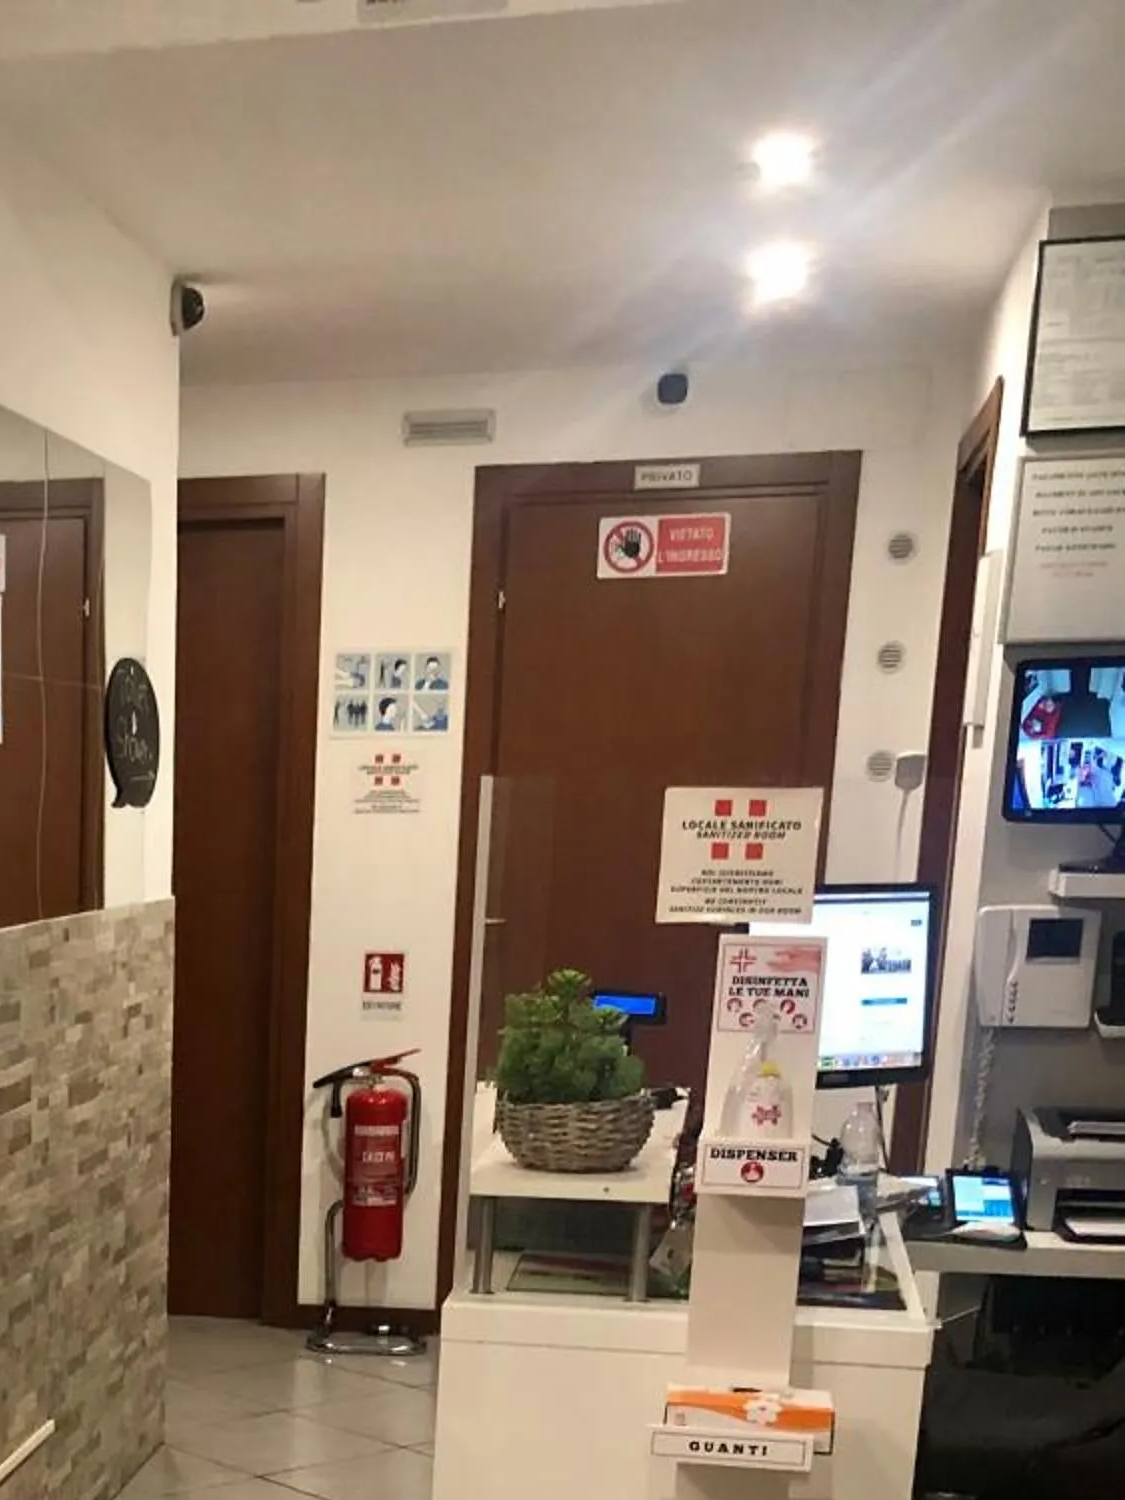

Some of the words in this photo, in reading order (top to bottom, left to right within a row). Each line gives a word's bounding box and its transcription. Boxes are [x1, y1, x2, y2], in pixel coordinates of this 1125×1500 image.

[641, 469, 693, 482] PRIVATO
[682, 820, 725, 830] LOCALE
[731, 820, 802, 830] SANIFICATO
[732, 975, 808, 986] DISINFETTA
[728, 987, 747, 997] LE
[749, 987, 772, 997] TUE
[774, 987, 809, 998] MANI
[709, 1147, 798, 1162] DISPENSER
[688, 1440, 768, 1456] GUANTI
